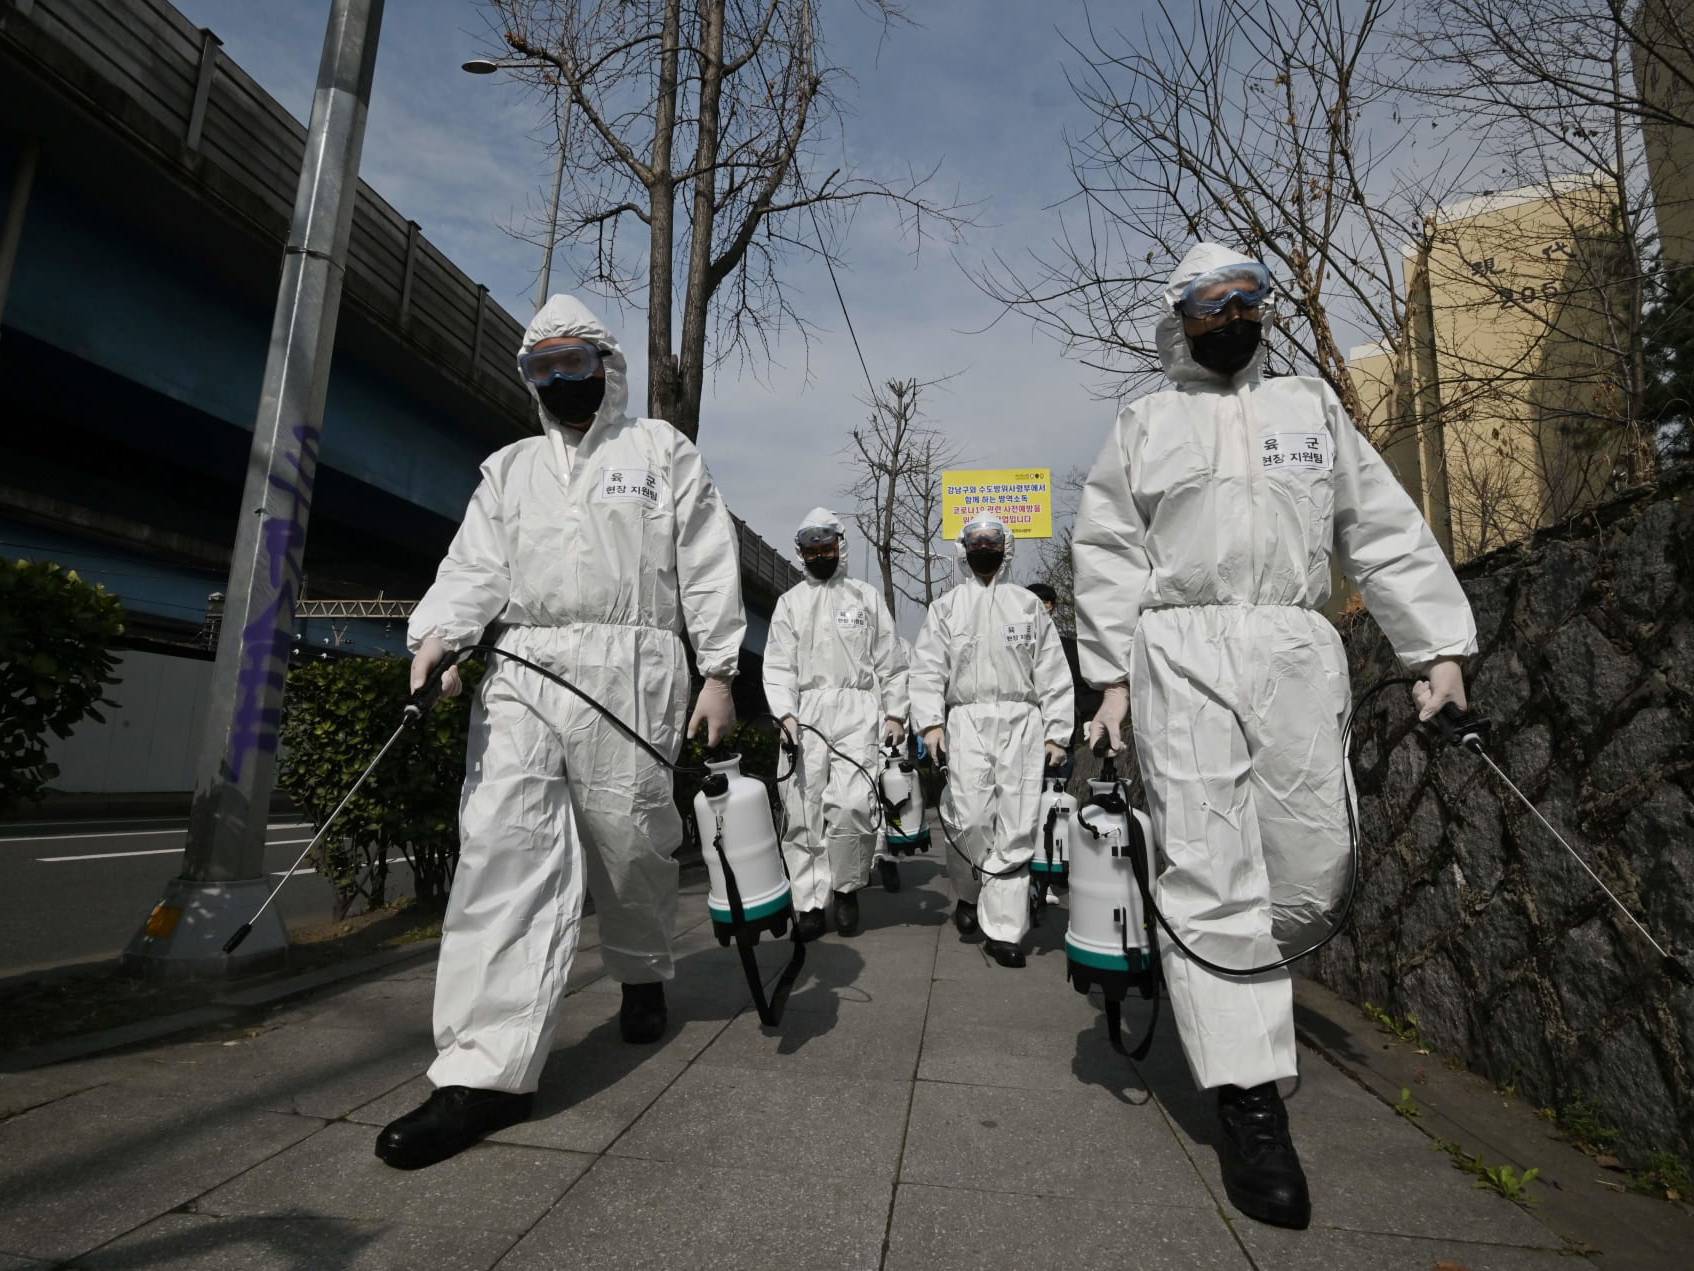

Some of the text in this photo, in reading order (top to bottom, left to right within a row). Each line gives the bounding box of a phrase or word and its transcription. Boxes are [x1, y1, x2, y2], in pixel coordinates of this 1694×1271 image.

[1262, 451, 1323, 467] 현장 지원팀
[606, 485, 658, 501] 현장 지원팀
[947, 485, 977, 495] 강남구와
[965, 494, 1028, 504] 함께 하는 방역소독
